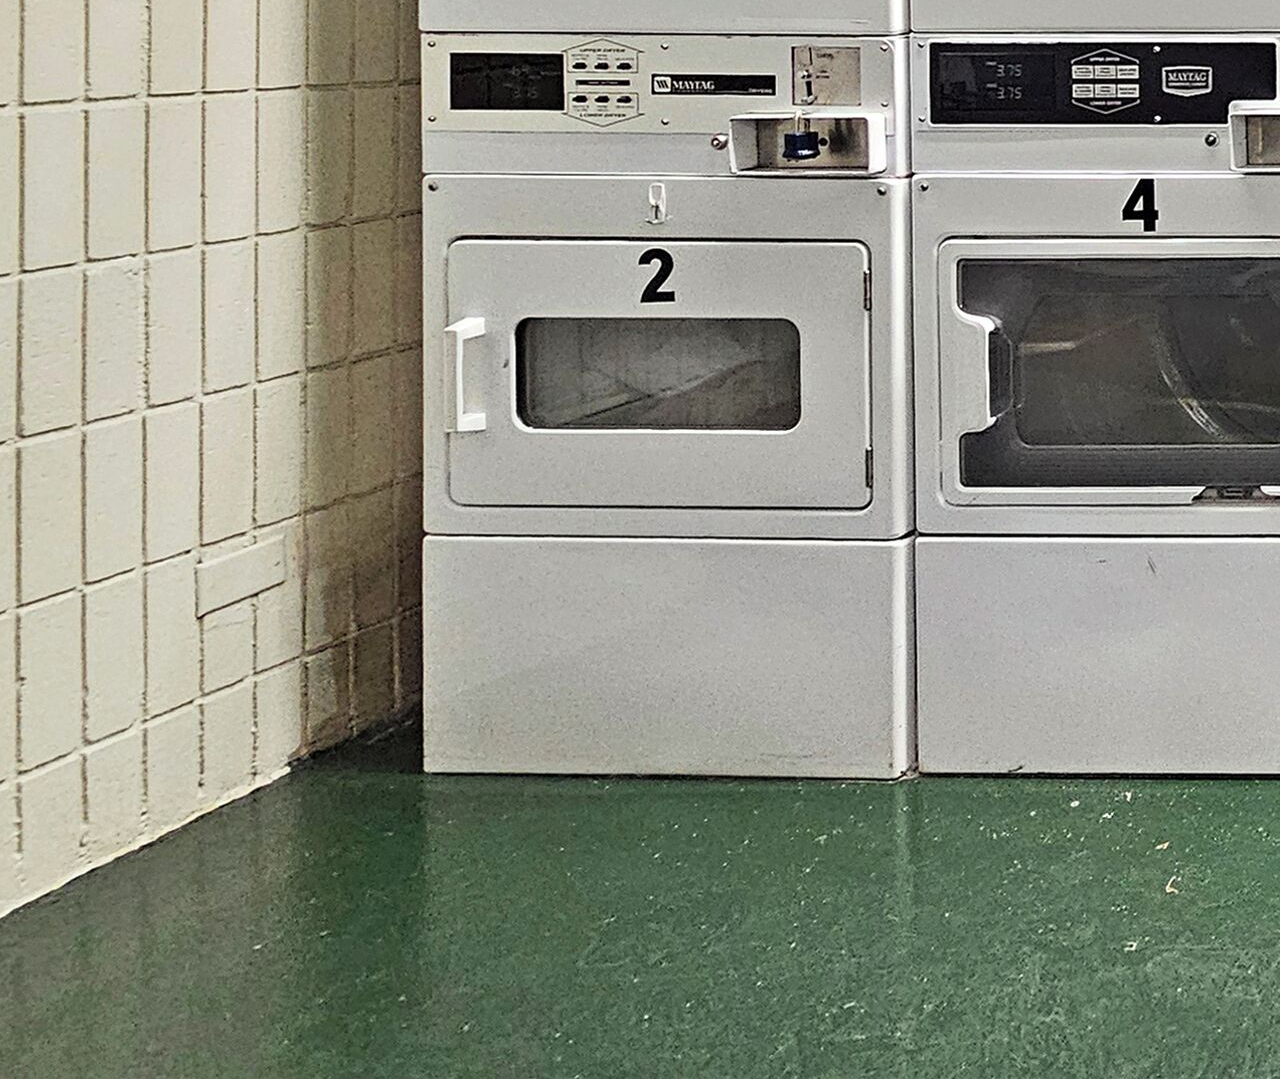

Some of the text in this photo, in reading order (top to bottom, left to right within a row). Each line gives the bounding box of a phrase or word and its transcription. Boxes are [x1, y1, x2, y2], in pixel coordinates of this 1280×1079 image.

[672, 80, 715, 90] MAYTAG
[1168, 72, 1207, 81] MAYTAG
[1122, 178, 1159, 232] 4
[638, 248, 676, 304] 2
